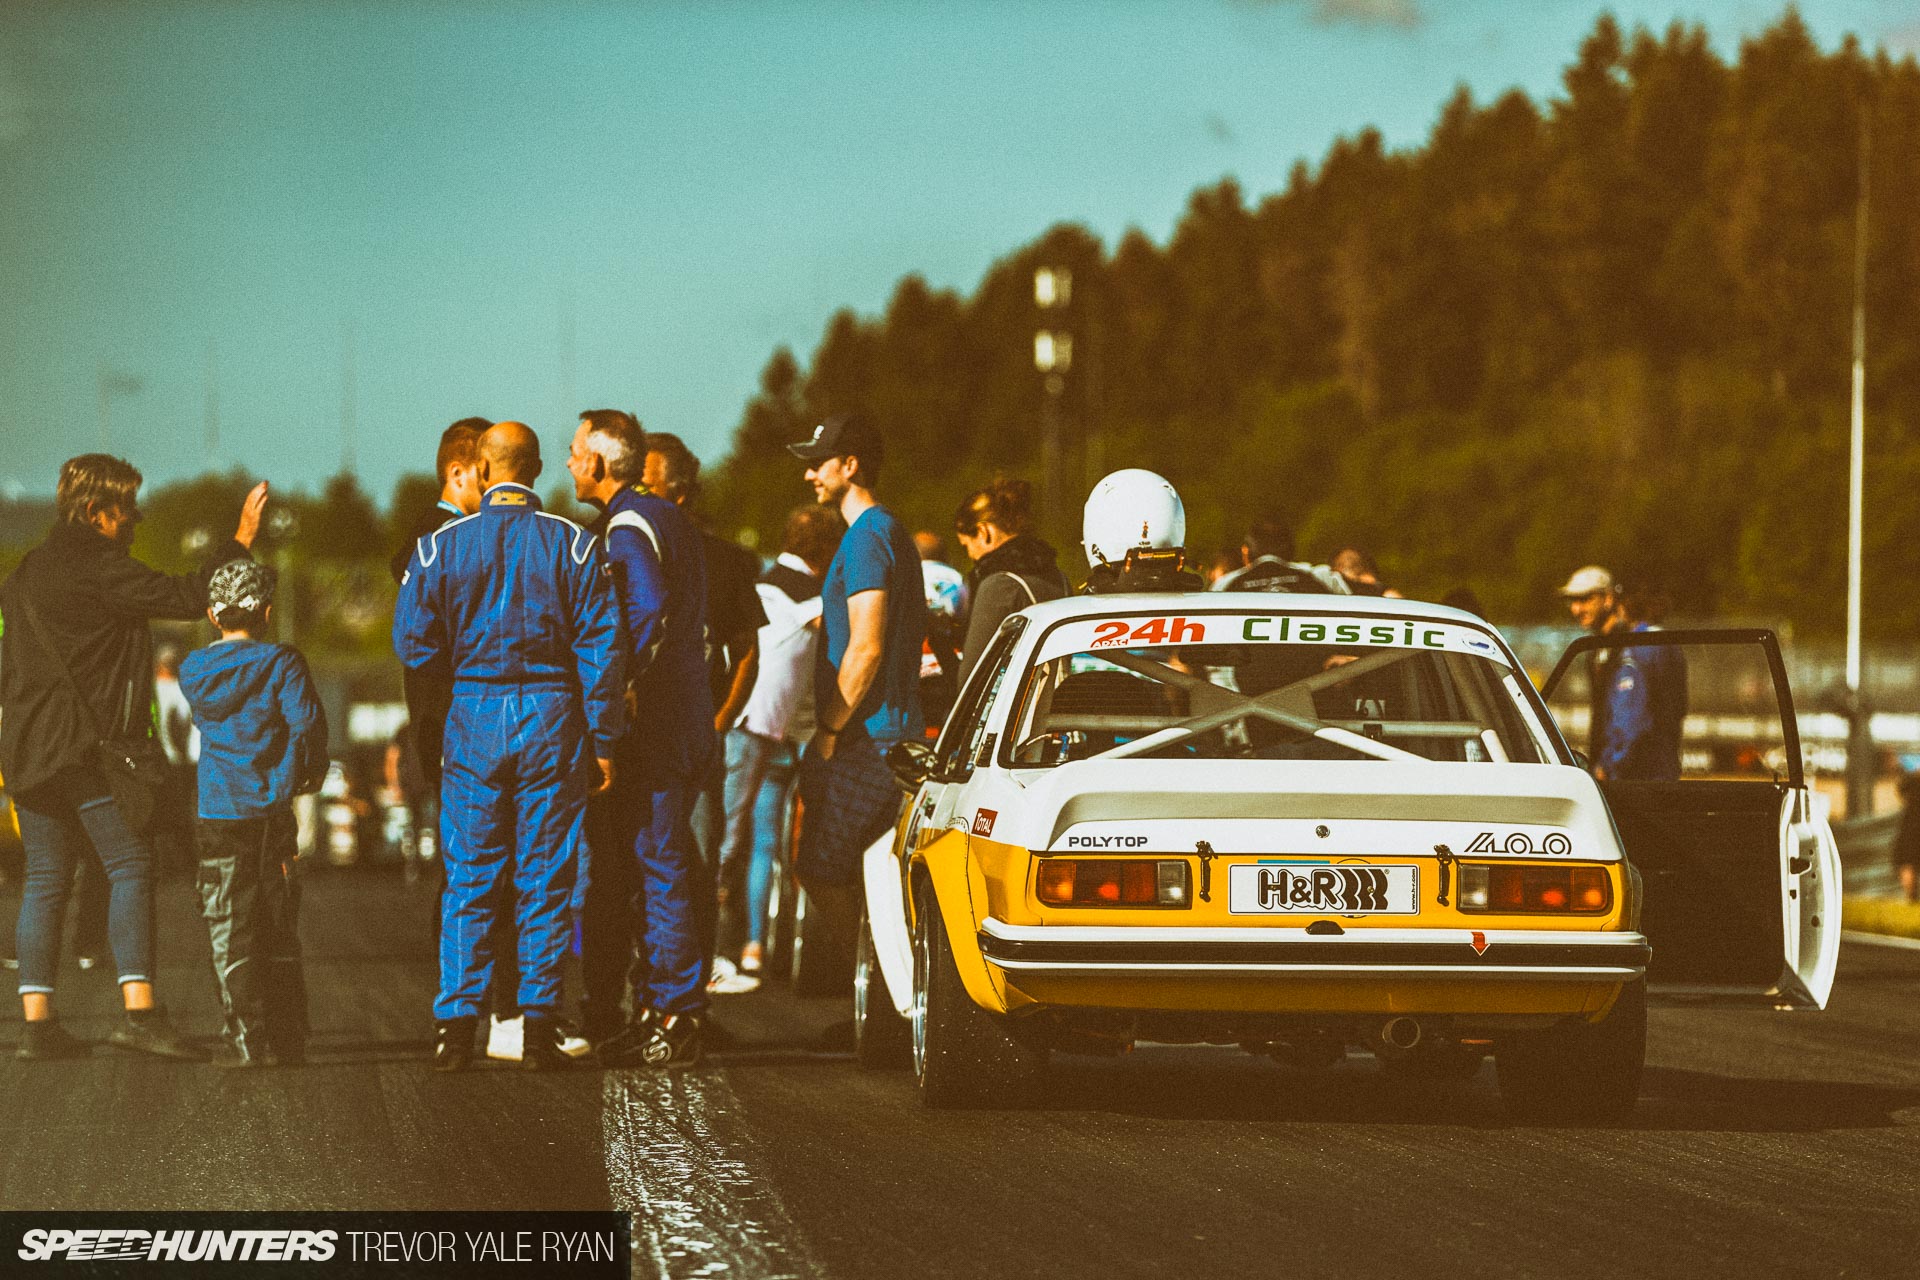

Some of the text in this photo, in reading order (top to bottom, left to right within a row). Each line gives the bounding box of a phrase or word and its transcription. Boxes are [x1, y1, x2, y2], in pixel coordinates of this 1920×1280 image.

[1090, 616, 1445, 648] 24h Classic
[974, 812, 992, 834] TOTAL
[1068, 836, 1148, 848] POLYTOP
[1463, 832, 1572, 855] 400
[1258, 868, 1344, 910] H&R
